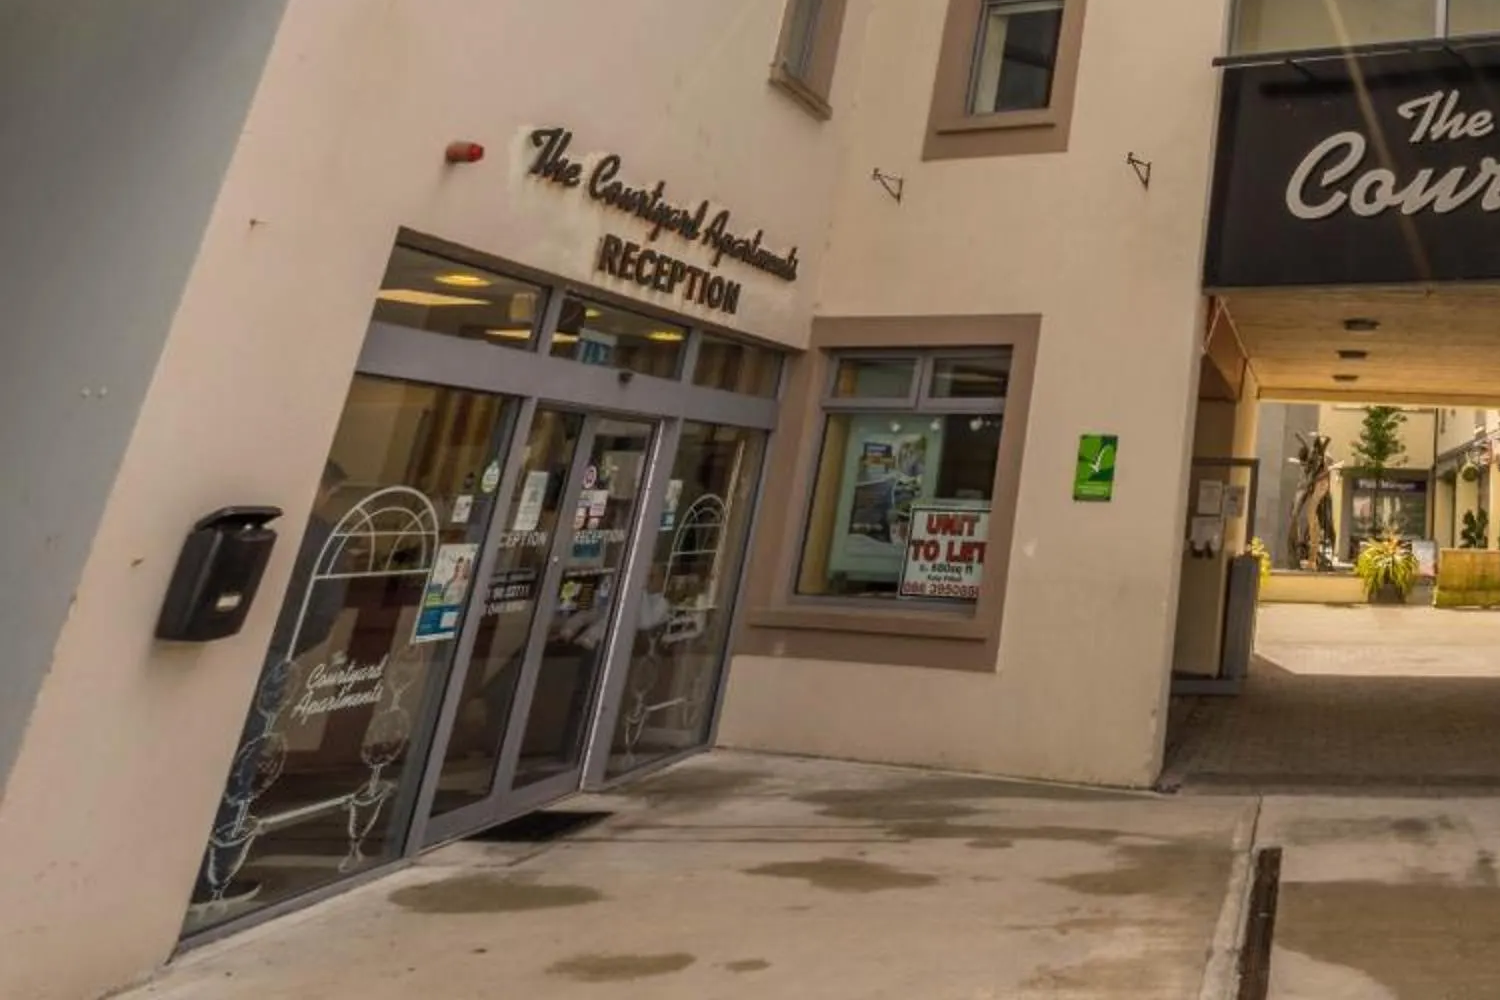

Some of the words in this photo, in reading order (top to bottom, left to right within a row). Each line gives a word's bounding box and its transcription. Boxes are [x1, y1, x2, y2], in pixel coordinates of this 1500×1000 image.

[1397, 90, 1496, 144] The
[526, 127, 583, 188] The
[588, 153, 710, 242] Courtyard
[701, 209, 800, 282] Apartments
[597, 232, 743, 315] RECEPTION
[926, 513, 979, 536] UNIT
[909, 539, 940, 562] TO
[946, 540, 986, 565] LET
[305, 653, 389, 692] Courtyard
[290, 678, 384, 726] Apartments
